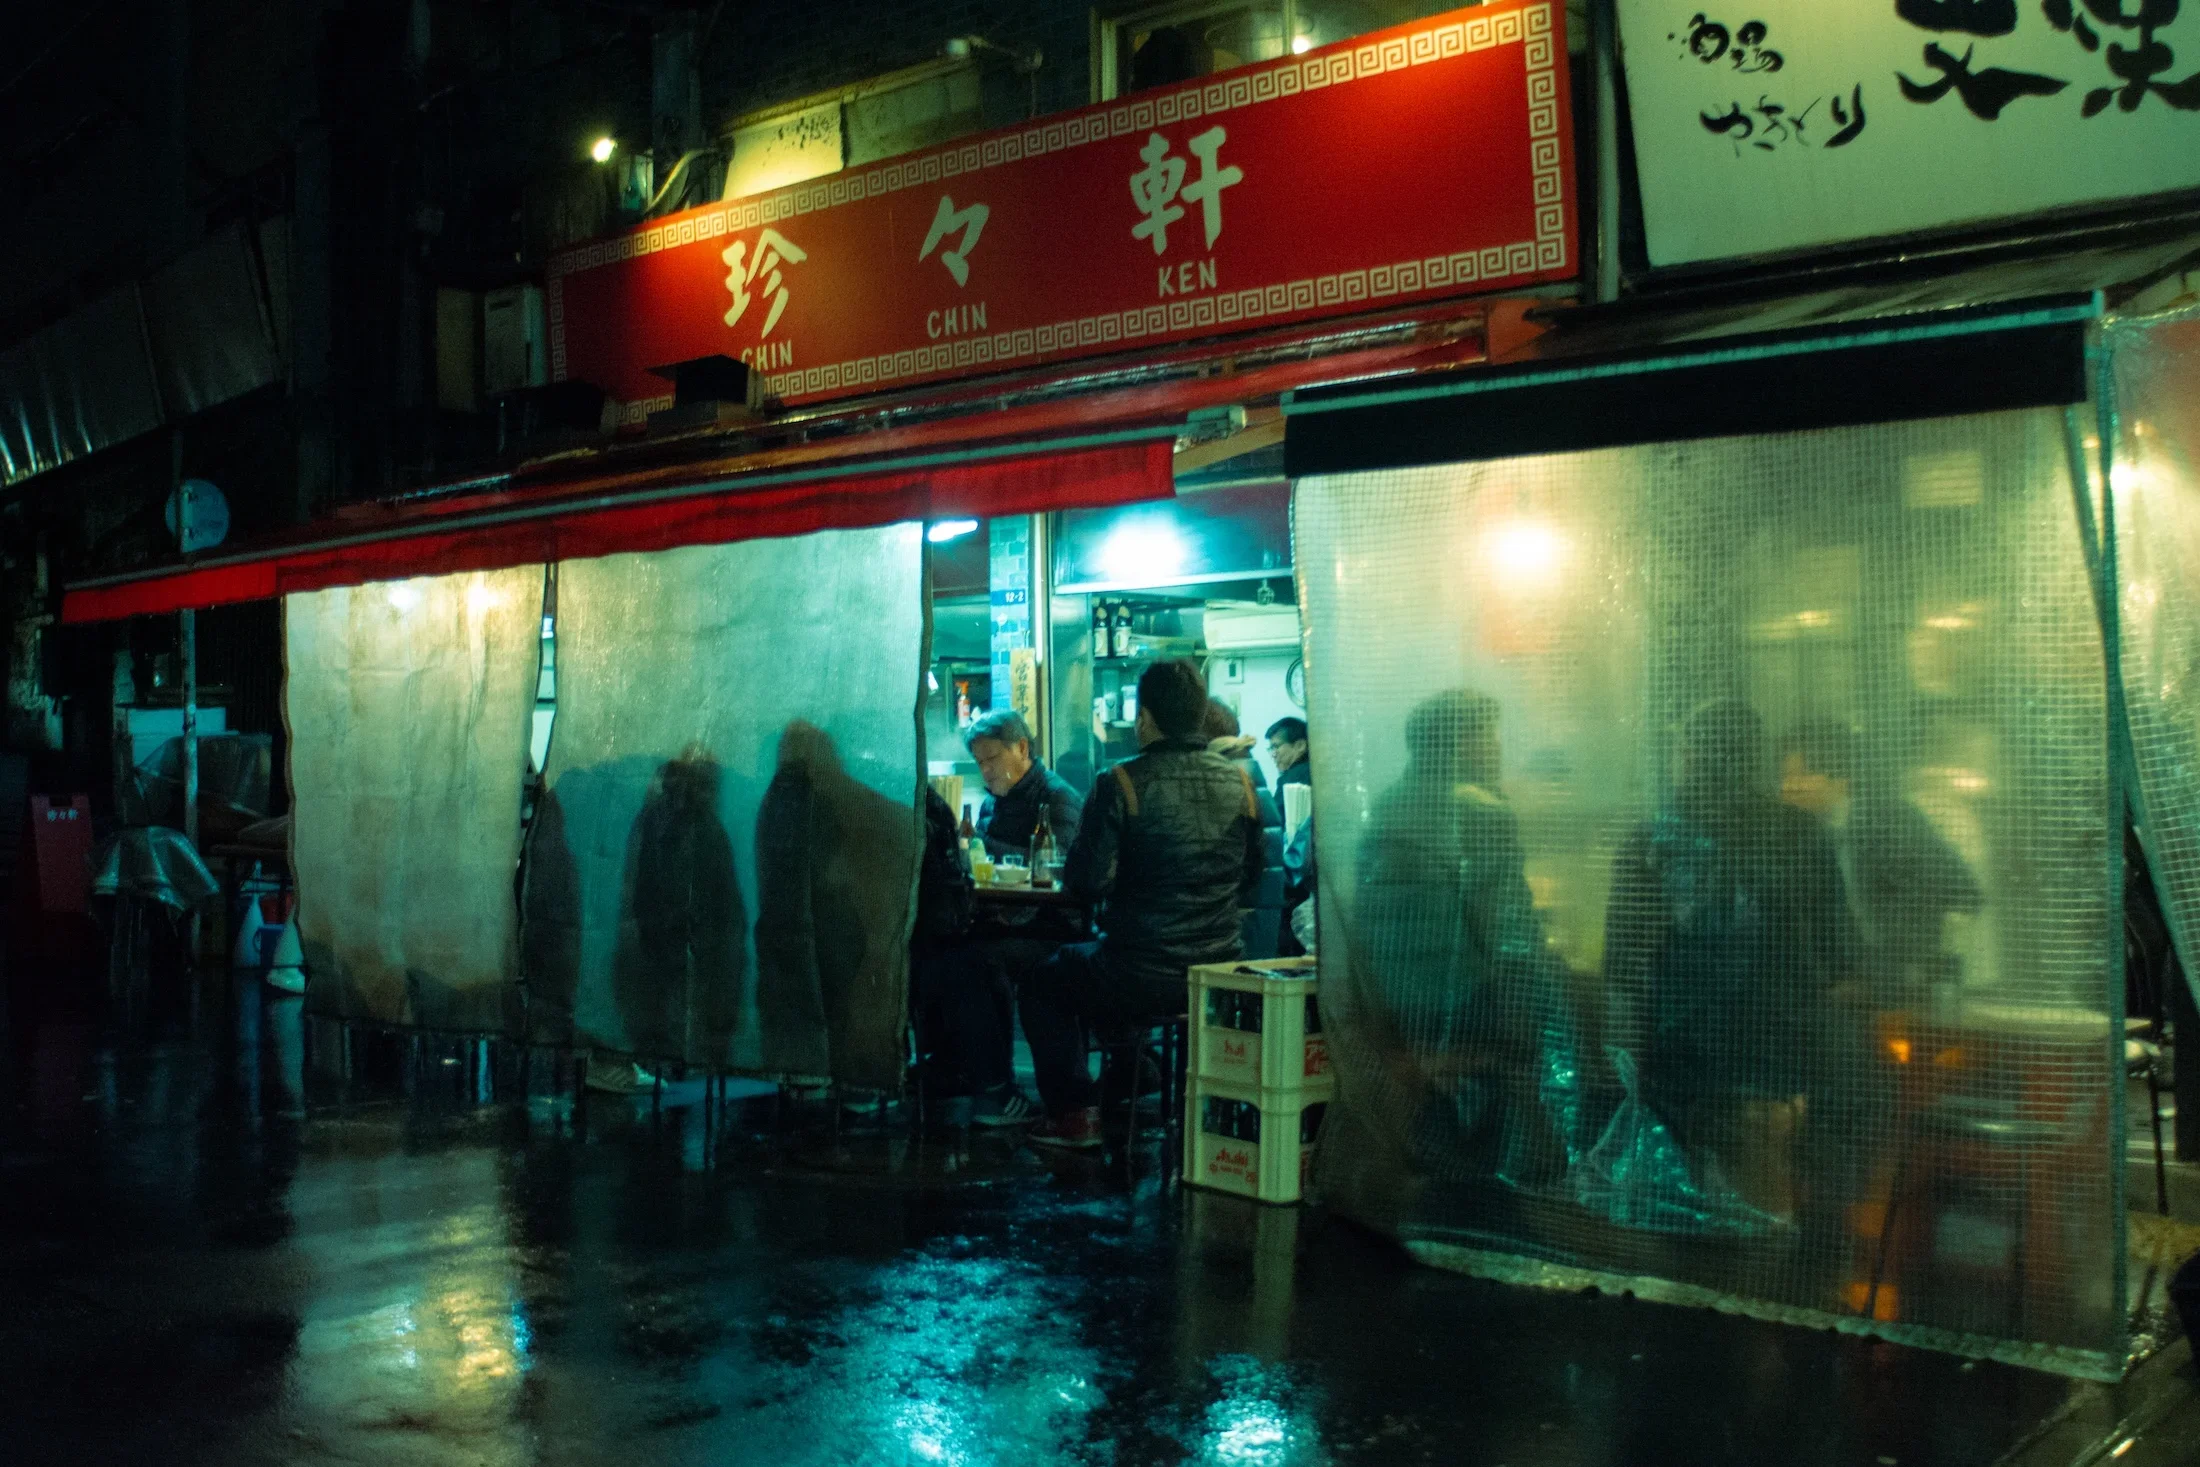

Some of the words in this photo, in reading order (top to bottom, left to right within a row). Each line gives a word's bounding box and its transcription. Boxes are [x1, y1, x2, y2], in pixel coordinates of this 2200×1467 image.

[1699, 82, 1866, 158] やきとり
[927, 301, 988, 339] CHIN
[1158, 258, 1217, 297] KEN
